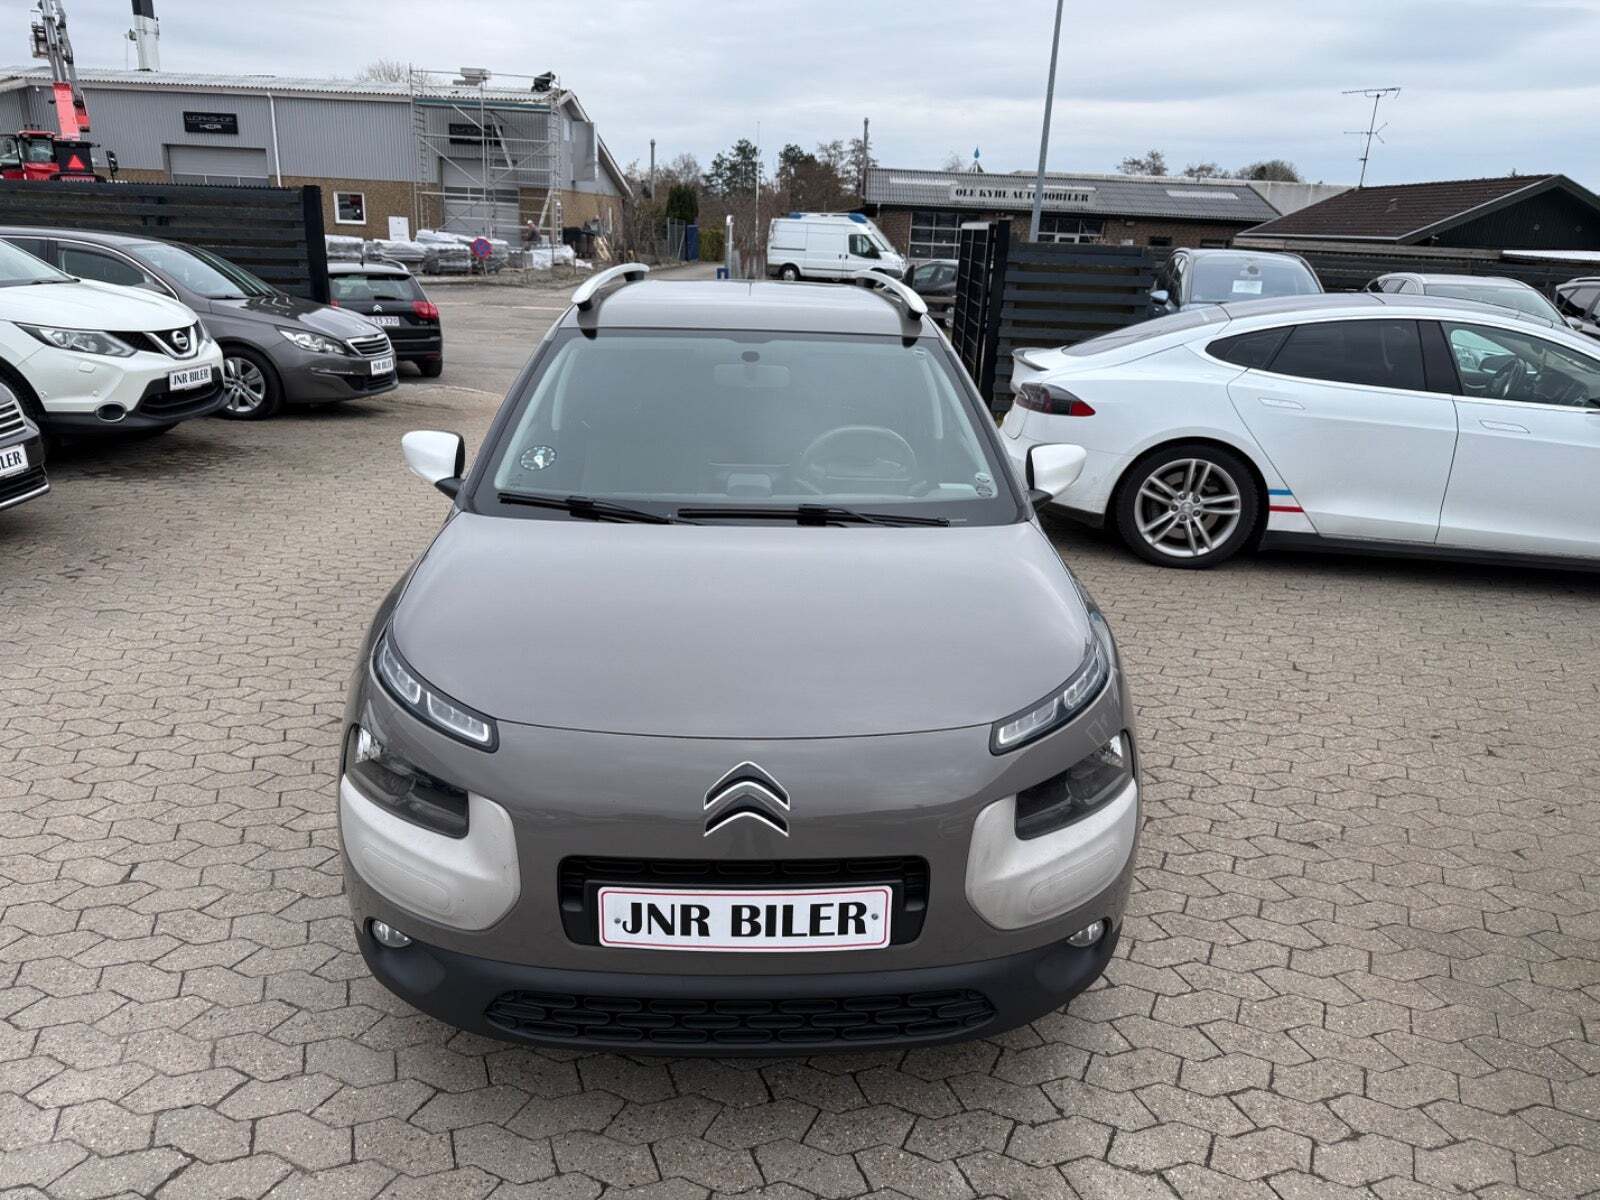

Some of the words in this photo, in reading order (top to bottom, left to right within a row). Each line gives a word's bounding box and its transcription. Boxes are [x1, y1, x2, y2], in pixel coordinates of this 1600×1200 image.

[955, 189, 976, 197] OLE
[173, 373, 188, 385] JNR
[189, 368, 209, 382] BILER
[0, 451, 22, 469] LER
[622, 902, 710, 936] JNR
[731, 901, 867, 937] BILER
